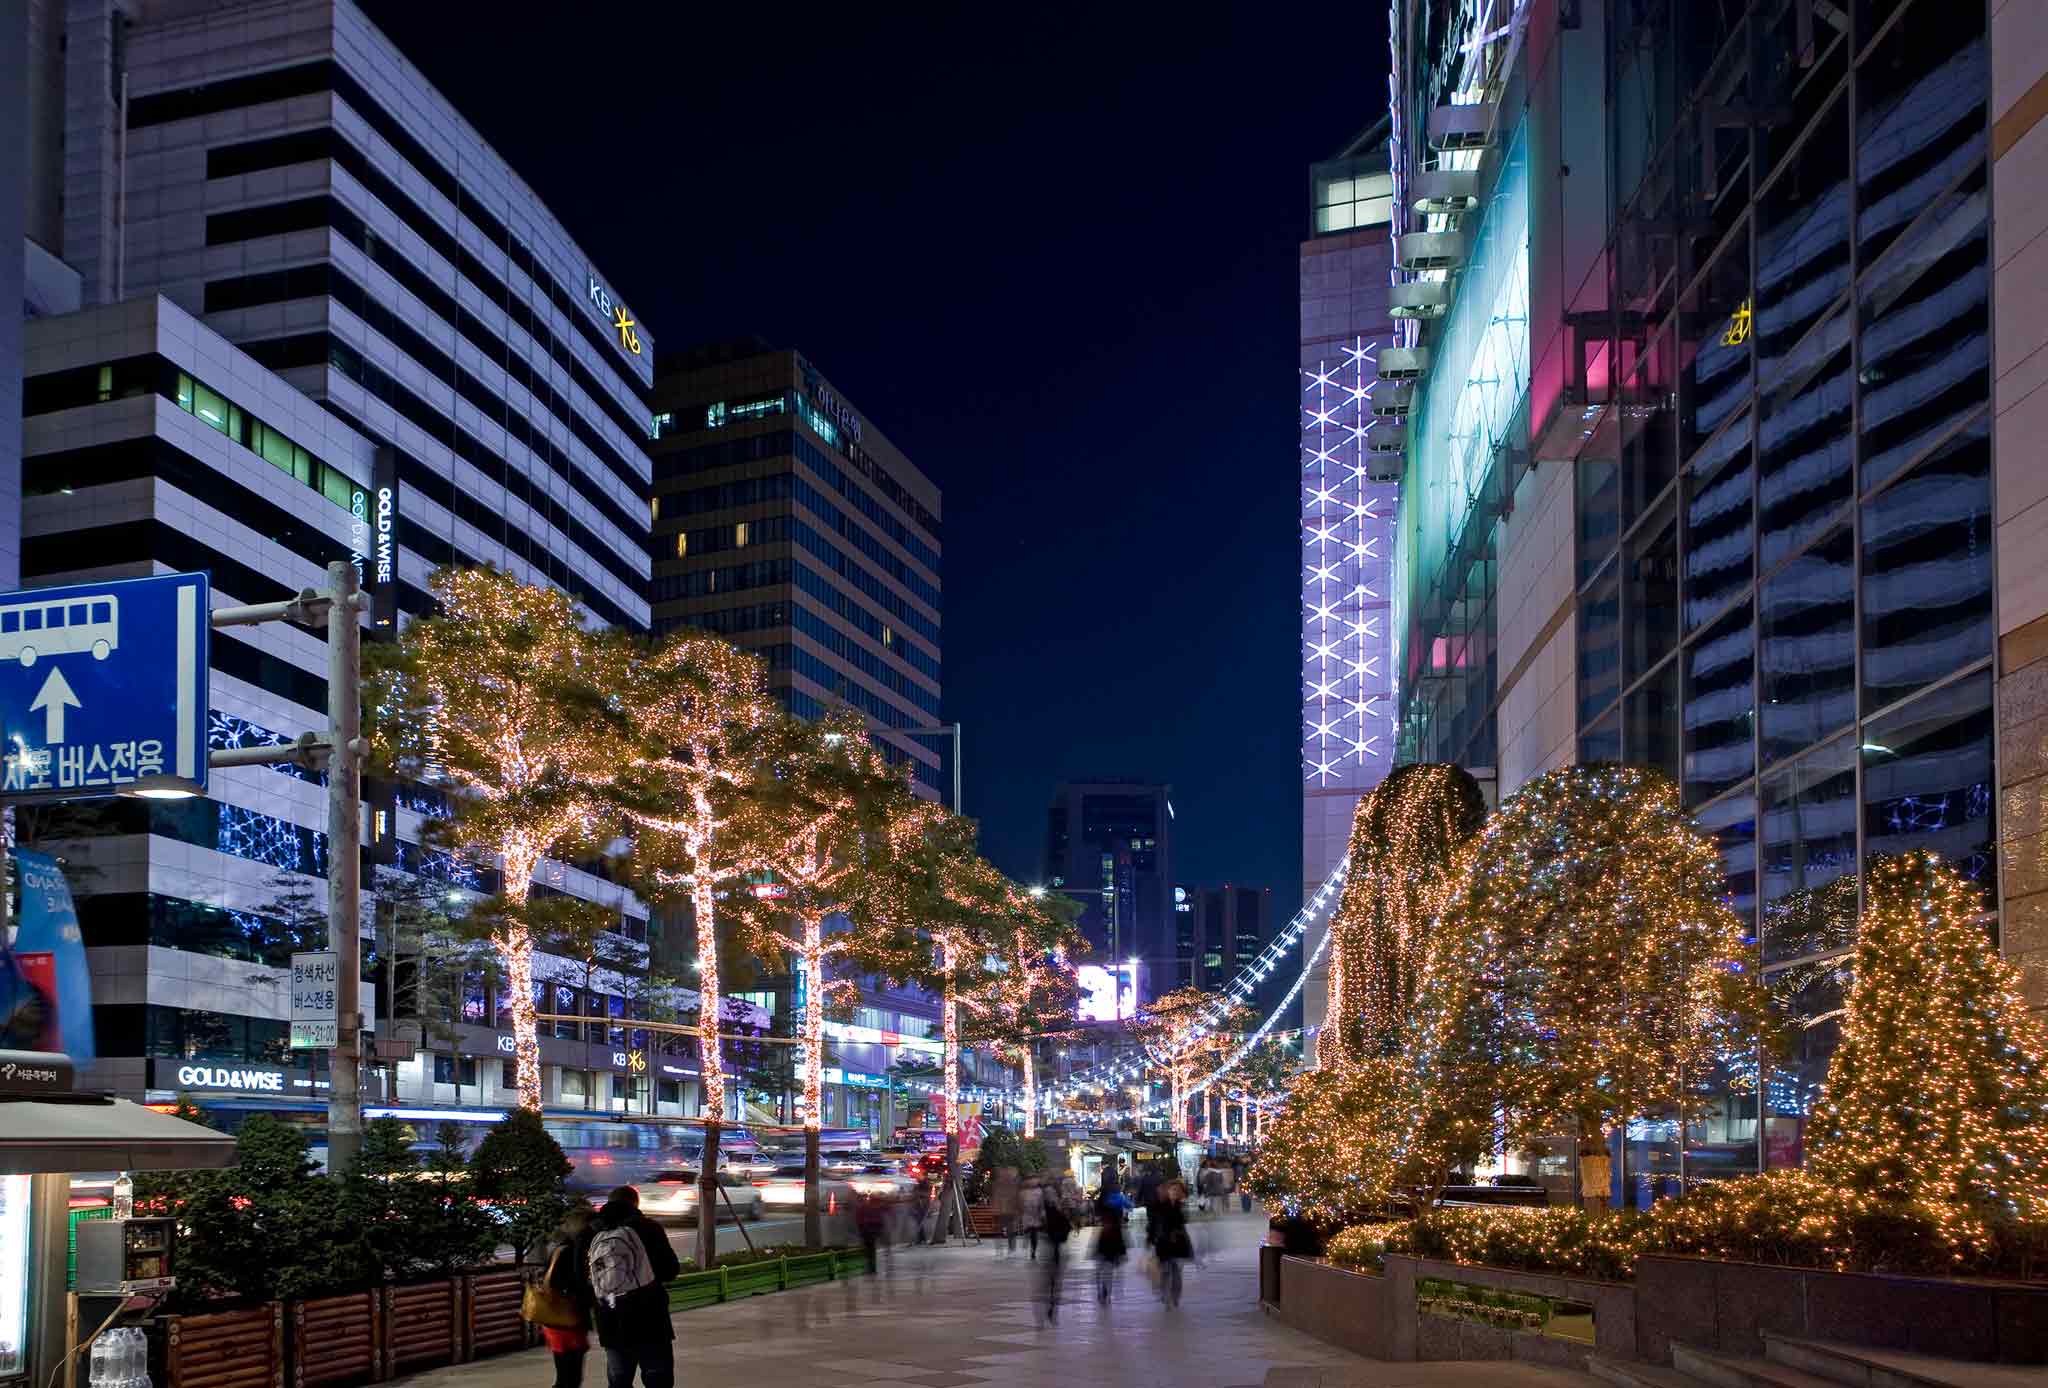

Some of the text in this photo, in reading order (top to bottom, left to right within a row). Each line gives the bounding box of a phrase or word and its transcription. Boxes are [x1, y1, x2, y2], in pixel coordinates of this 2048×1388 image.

[590, 278, 611, 317] KB
[58, 739, 164, 788] 버스전용
[294, 962, 335, 983] 청색차선
[294, 990, 335, 1010] 버스전용
[497, 1035, 515, 1052] KB
[612, 1051, 626, 1067] KB
[178, 1065, 284, 1091] GOLD&WISE
